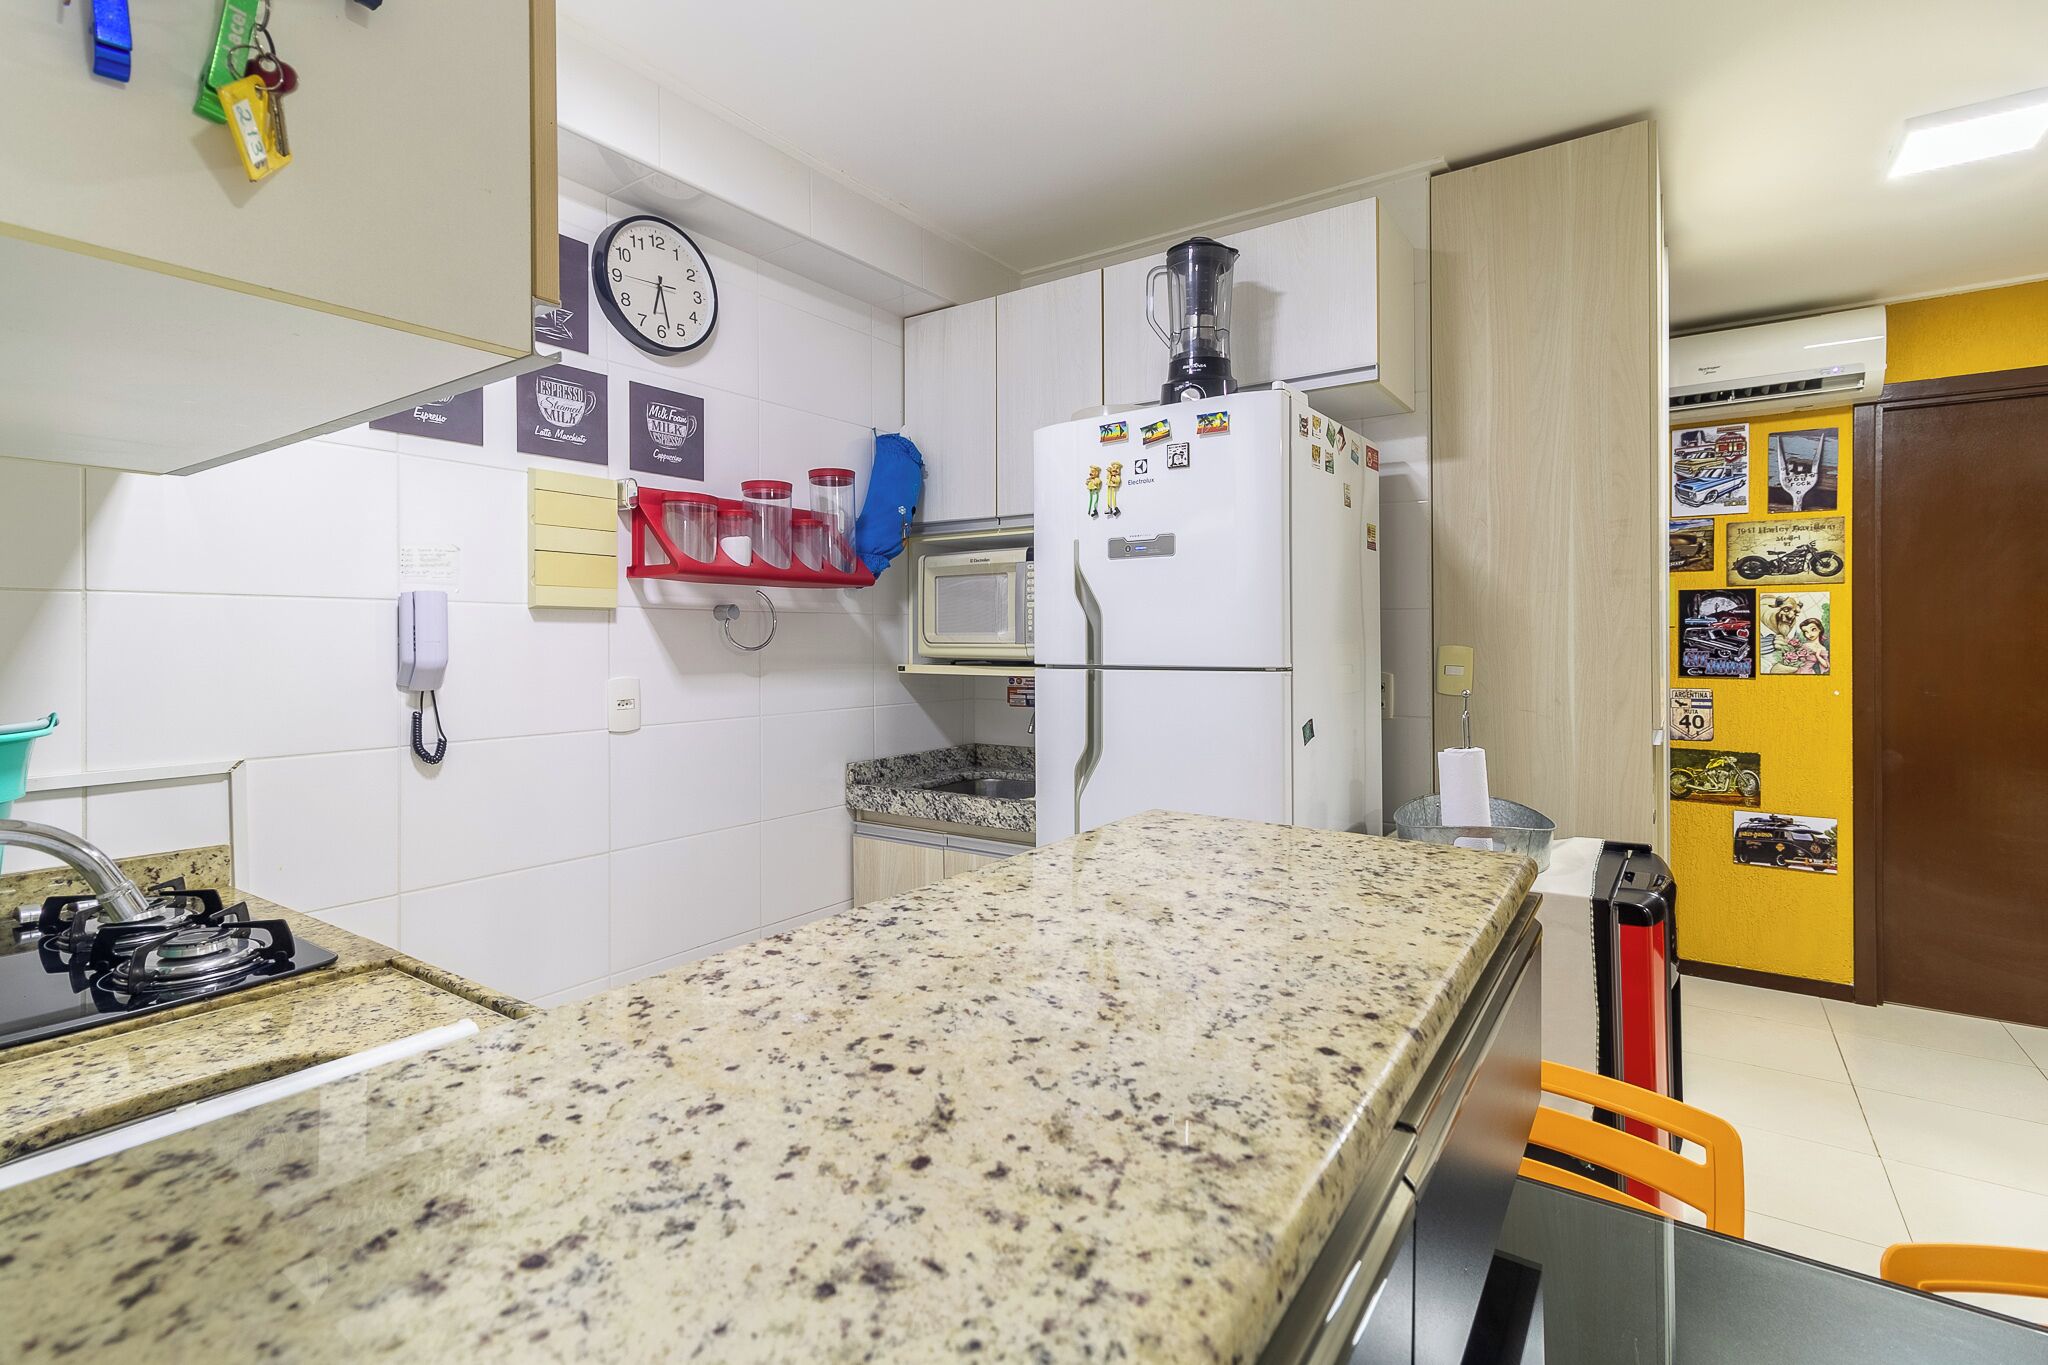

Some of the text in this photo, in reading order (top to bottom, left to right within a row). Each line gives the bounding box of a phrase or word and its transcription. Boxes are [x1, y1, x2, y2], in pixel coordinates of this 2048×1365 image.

[629, 234, 644, 250] 11
[648, 234, 666, 250] 12
[615, 246, 631, 263] 10
[672, 248, 679, 261] 1
[611, 268, 623, 283] 9
[686, 269, 696, 282] 2
[620, 292, 631, 306] 8
[693, 291, 702, 304] 3
[637, 313, 647, 326] 7
[689, 311, 698, 324] 4
[657, 325, 667, 339] 6
[676, 324, 686, 337] 5
[539, 380, 584, 402] ESPRESSO
[540, 397, 583, 414] Steamed
[648, 404, 669, 420] Milk
[413, 406, 448, 423] Espresso
[543, 407, 579, 424] MILK
[534, 425, 588, 444] Latte Macchiato
[652, 420, 684, 437] MILK
[652, 448, 683, 463] Cappuccino
[1127, 478, 1155, 486] Electrolux
[1674, 691, 1709, 699] ARGENTINA
[1679, 714, 1705, 730] 40
